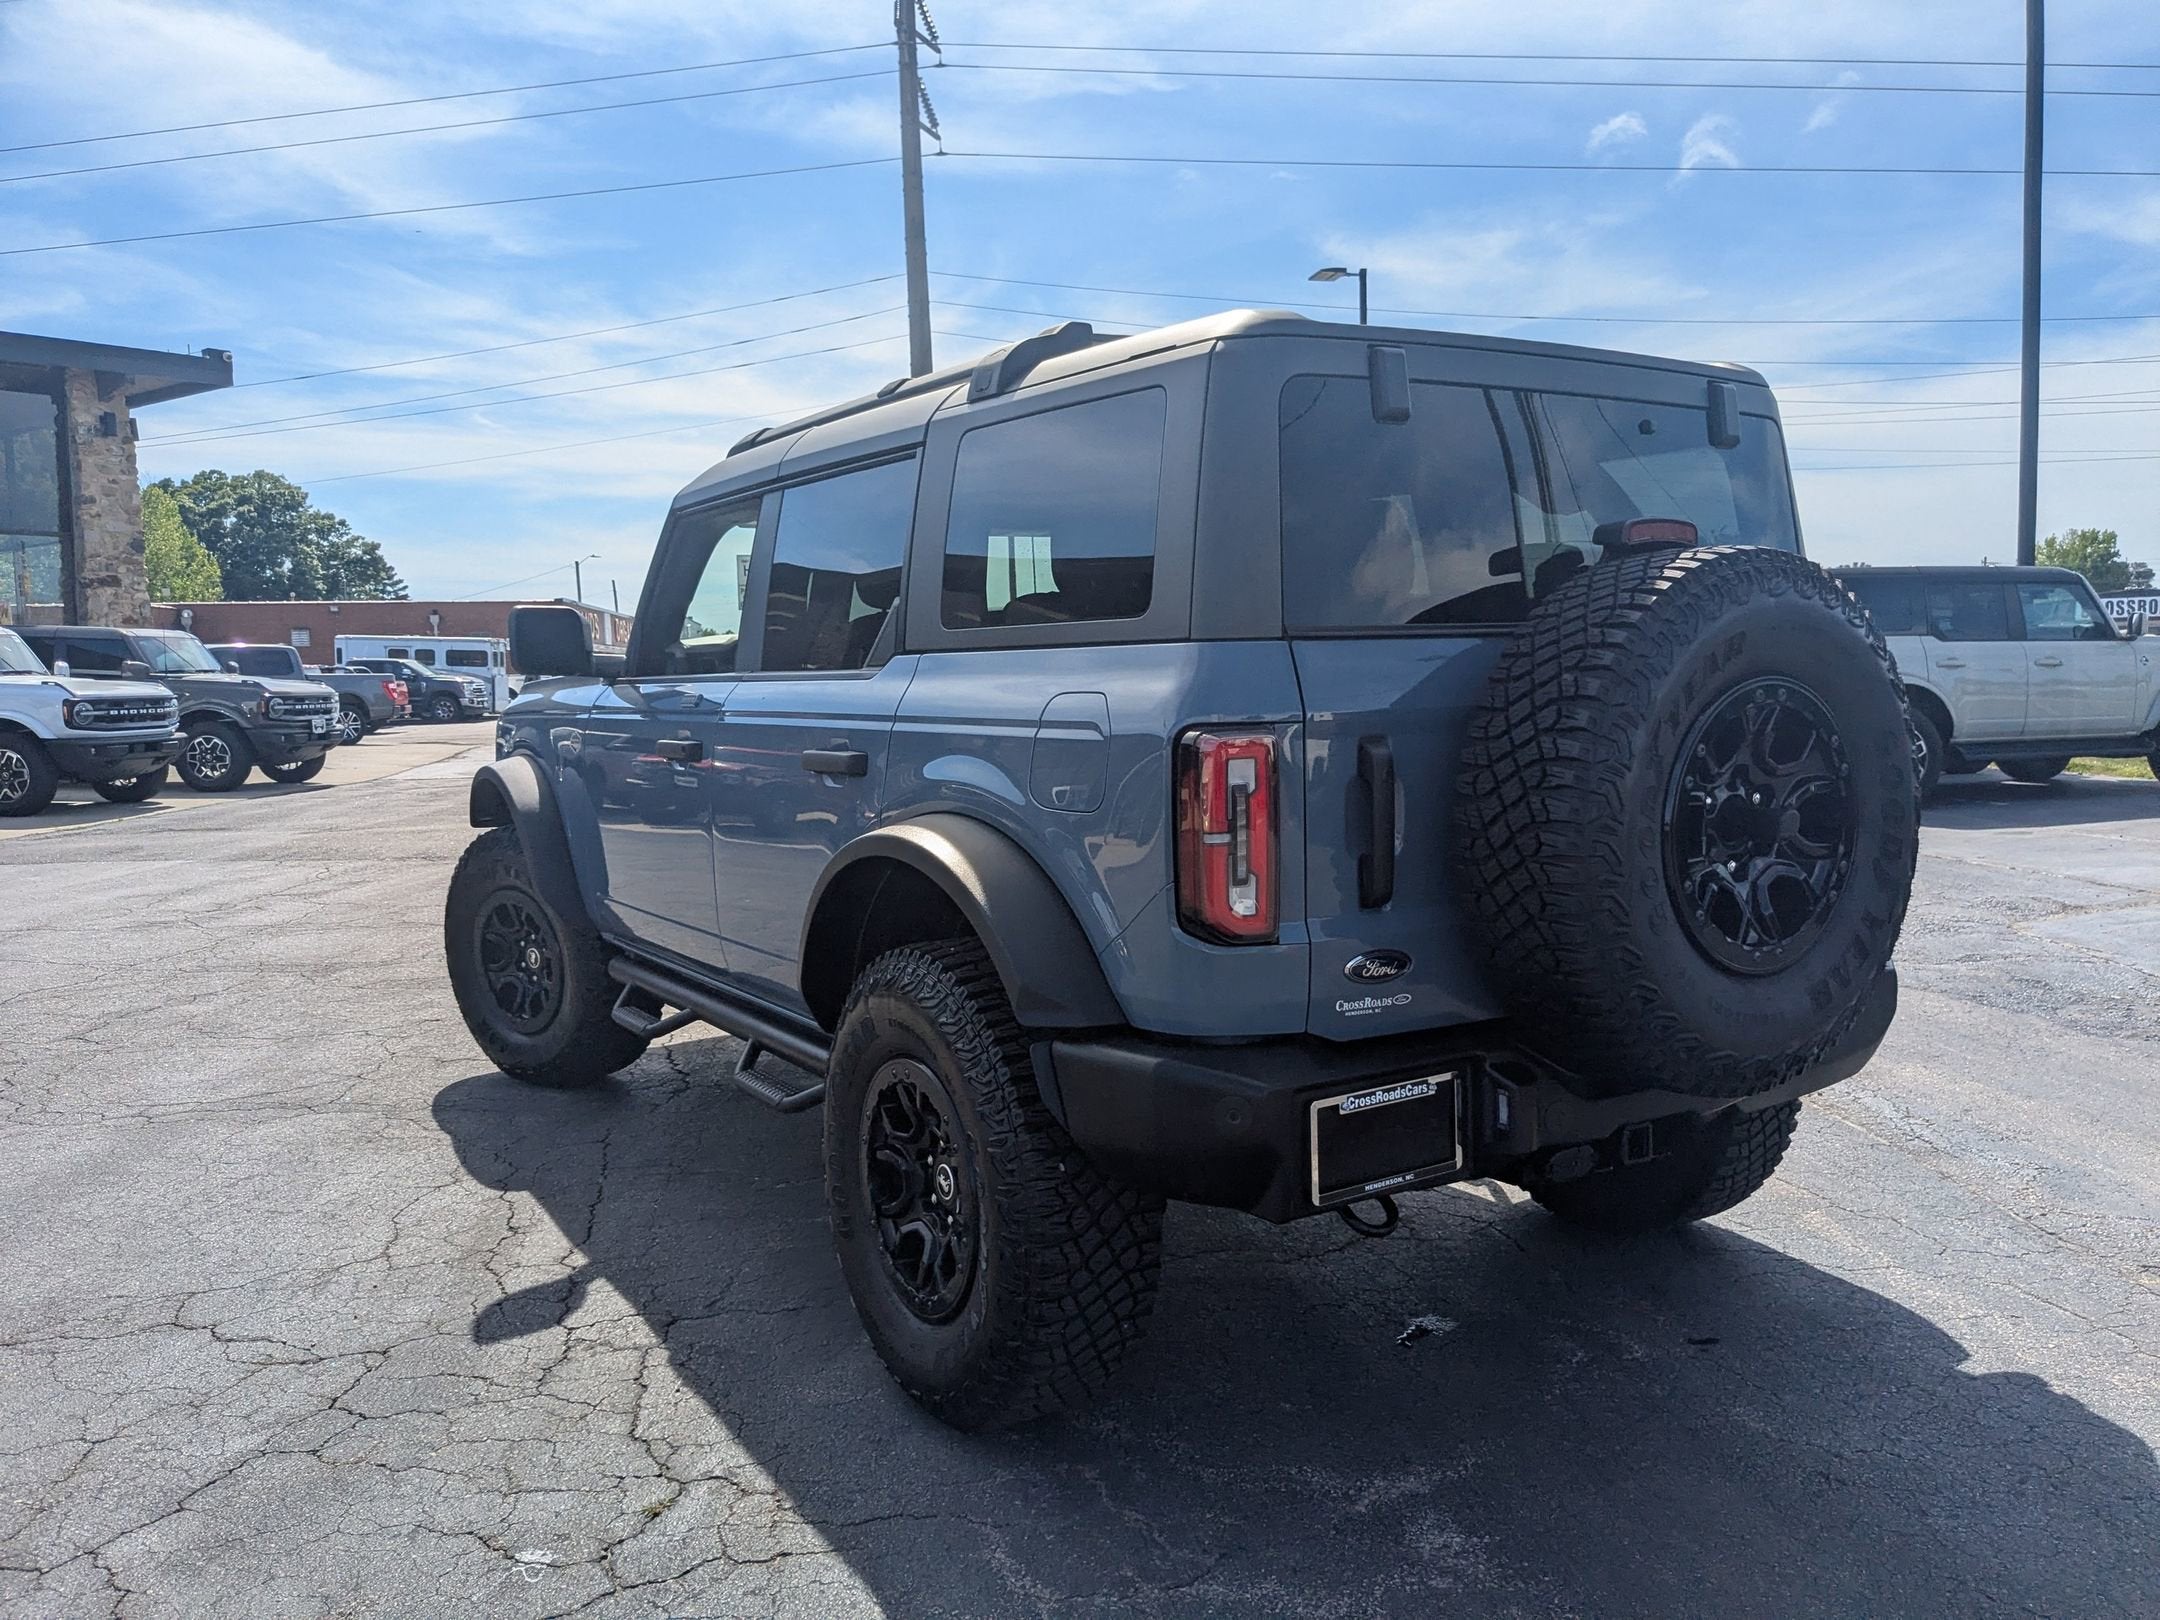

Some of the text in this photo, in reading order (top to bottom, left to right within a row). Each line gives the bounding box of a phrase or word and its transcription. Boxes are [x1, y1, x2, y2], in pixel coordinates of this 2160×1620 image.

[109, 707, 164, 715] BRONCO
[1362, 959, 1398, 977] Ford
[1347, 1082, 1428, 1110] CrossRoadsCars
[1364, 1174, 1415, 1192] HENDERSON, NC
